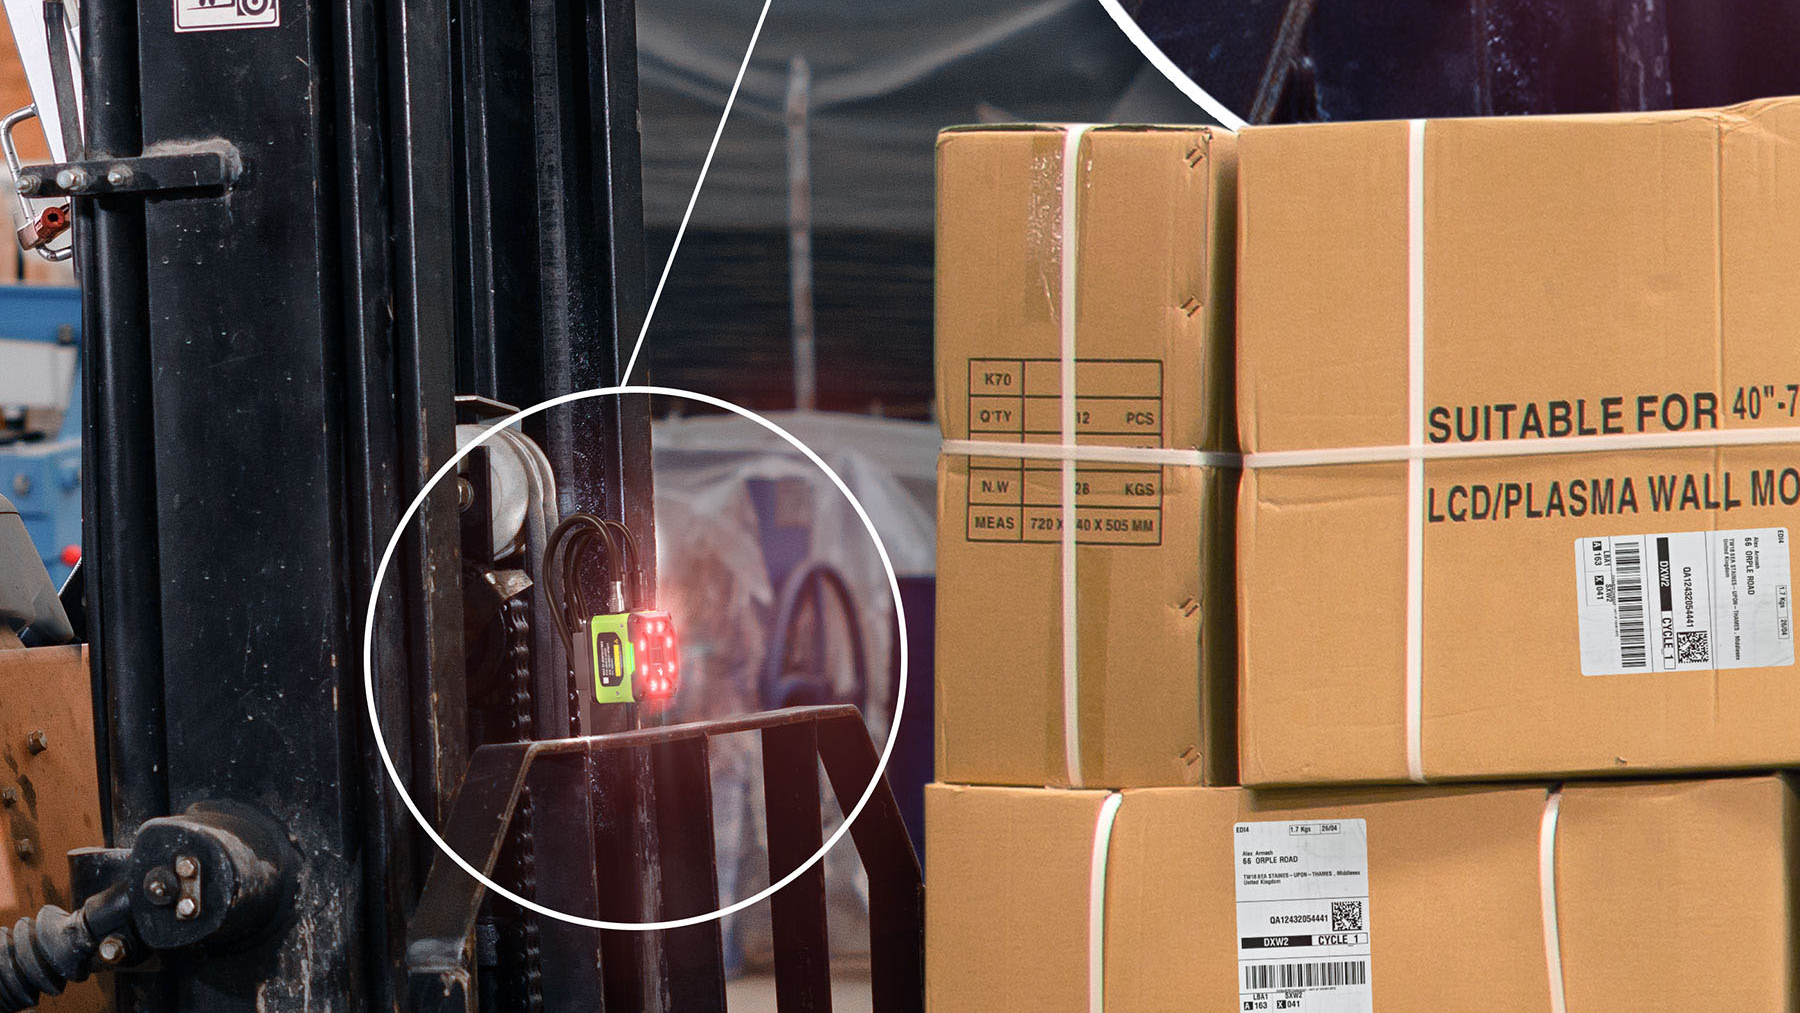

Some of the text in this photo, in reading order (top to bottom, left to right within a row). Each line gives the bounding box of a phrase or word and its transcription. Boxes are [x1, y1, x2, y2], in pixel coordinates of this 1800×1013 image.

[984, 372, 1012, 387] K70
[979, 409, 1012, 424] Q'TY
[1125, 411, 1155, 425] PCS
[1427, 395, 1625, 444] SUITABLE
[1636, 391, 1720, 433] FOR
[981, 479, 1010, 494] N.W
[1124, 482, 1156, 497] KGS
[1427, 475, 1640, 524] LCD/PLASMA
[1647, 470, 1742, 513] WALL
[974, 515, 1015, 530] MEAS
[1030, 517, 1054, 531] 720
[1094, 518, 1103, 532] X
[1105, 518, 1129, 532] 505
[1777, 529, 1785, 544] EDI4
[1594, 552, 1602, 566] 163
[1659, 560, 1670, 588] DXW2
[1746, 575, 1755, 595] ROAD
[1683, 566, 1694, 628] QA12432054441
[1662, 617, 1674, 649] CYCLE
[1280, 855, 1298, 863] ROAD
[1269, 914, 1328, 925] QA12432054441
[1263, 937, 1289, 947] DXW2
[1318, 934, 1348, 945] CYCLE
[1254, 1001, 1268, 1009] 163
[1287, 1000, 1300, 1008] 041
